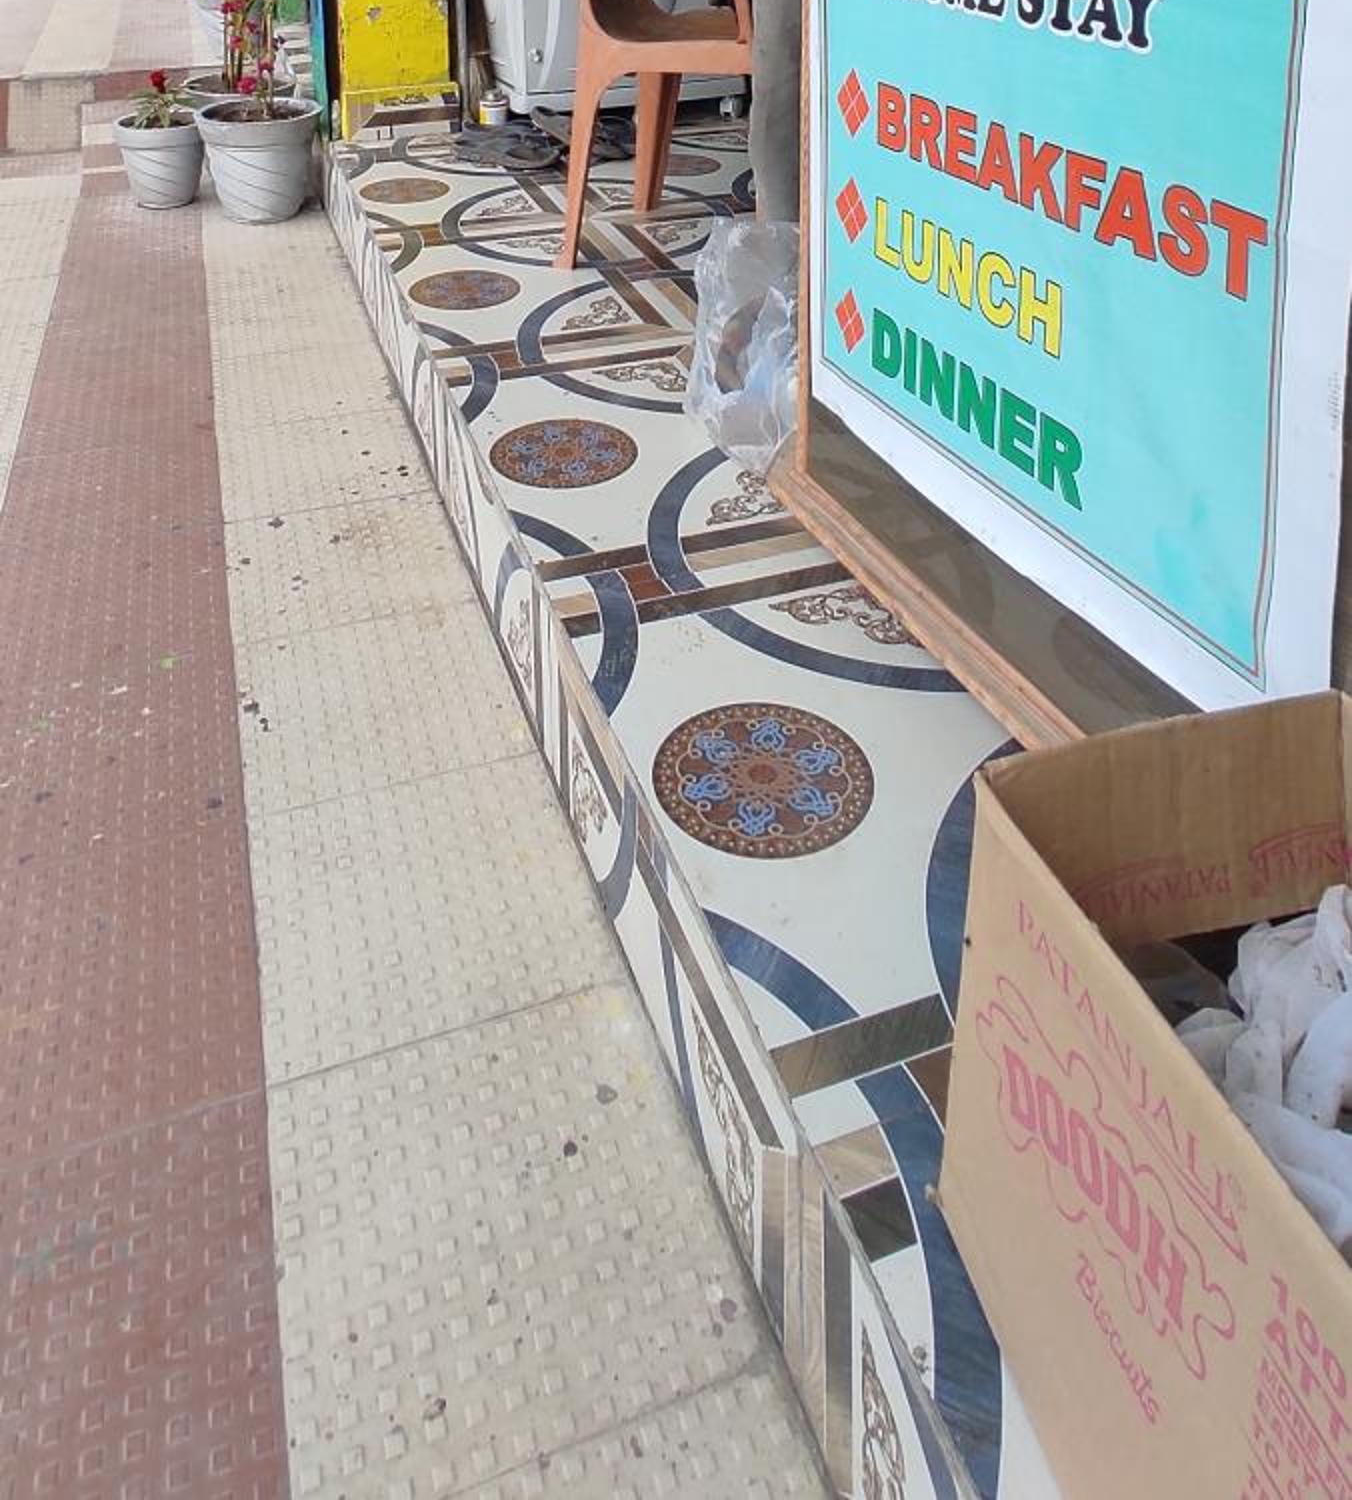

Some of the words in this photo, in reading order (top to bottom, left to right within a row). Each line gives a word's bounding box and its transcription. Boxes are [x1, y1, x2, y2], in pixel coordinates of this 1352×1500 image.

[873, 196, 1064, 360] LUNCH
[876, 81, 1269, 302] BREAKFAST
[870, 307, 1084, 512] DINNER
[1003, 1042, 1188, 1333] DOODH
[1075, 1250, 1160, 1424] Biscuits
